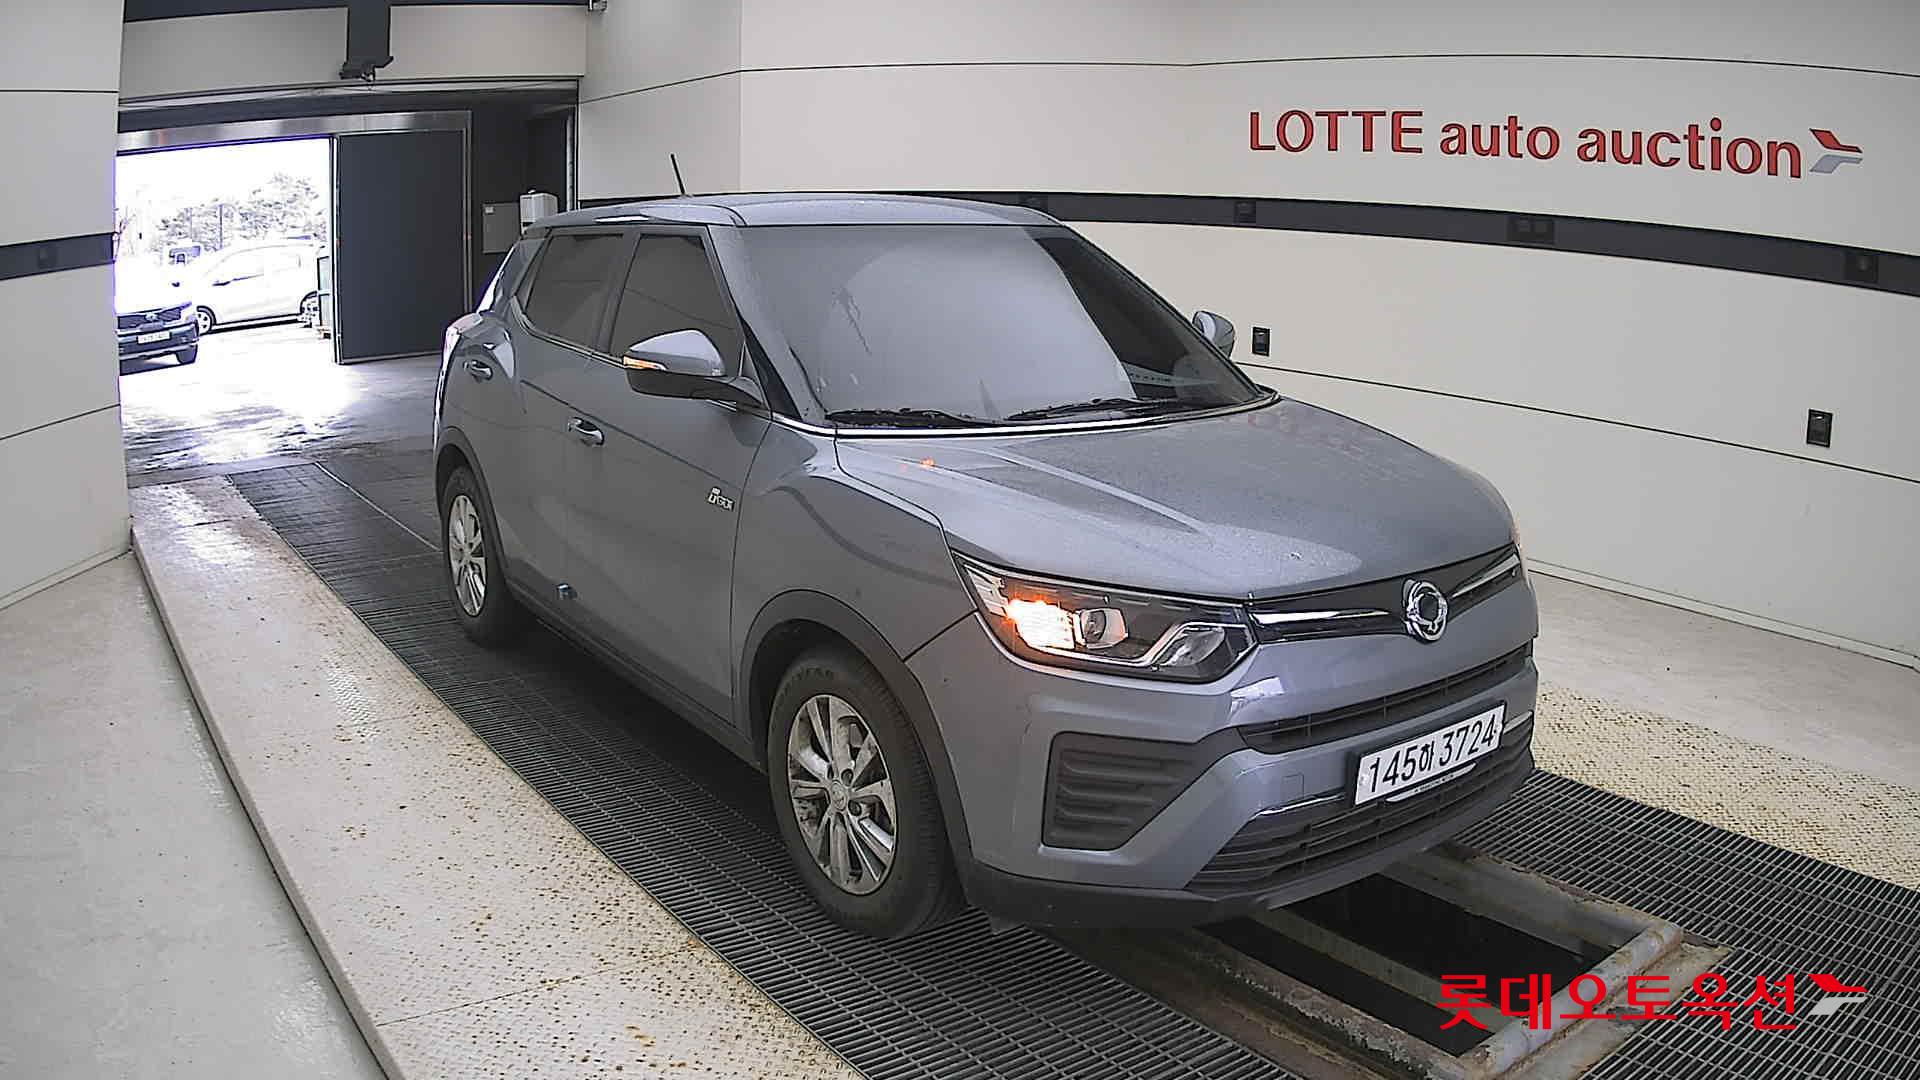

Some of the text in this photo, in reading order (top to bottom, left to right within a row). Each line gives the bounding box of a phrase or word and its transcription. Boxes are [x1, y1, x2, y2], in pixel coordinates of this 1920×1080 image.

[1249, 109, 1802, 178] LOTTE auto auction
